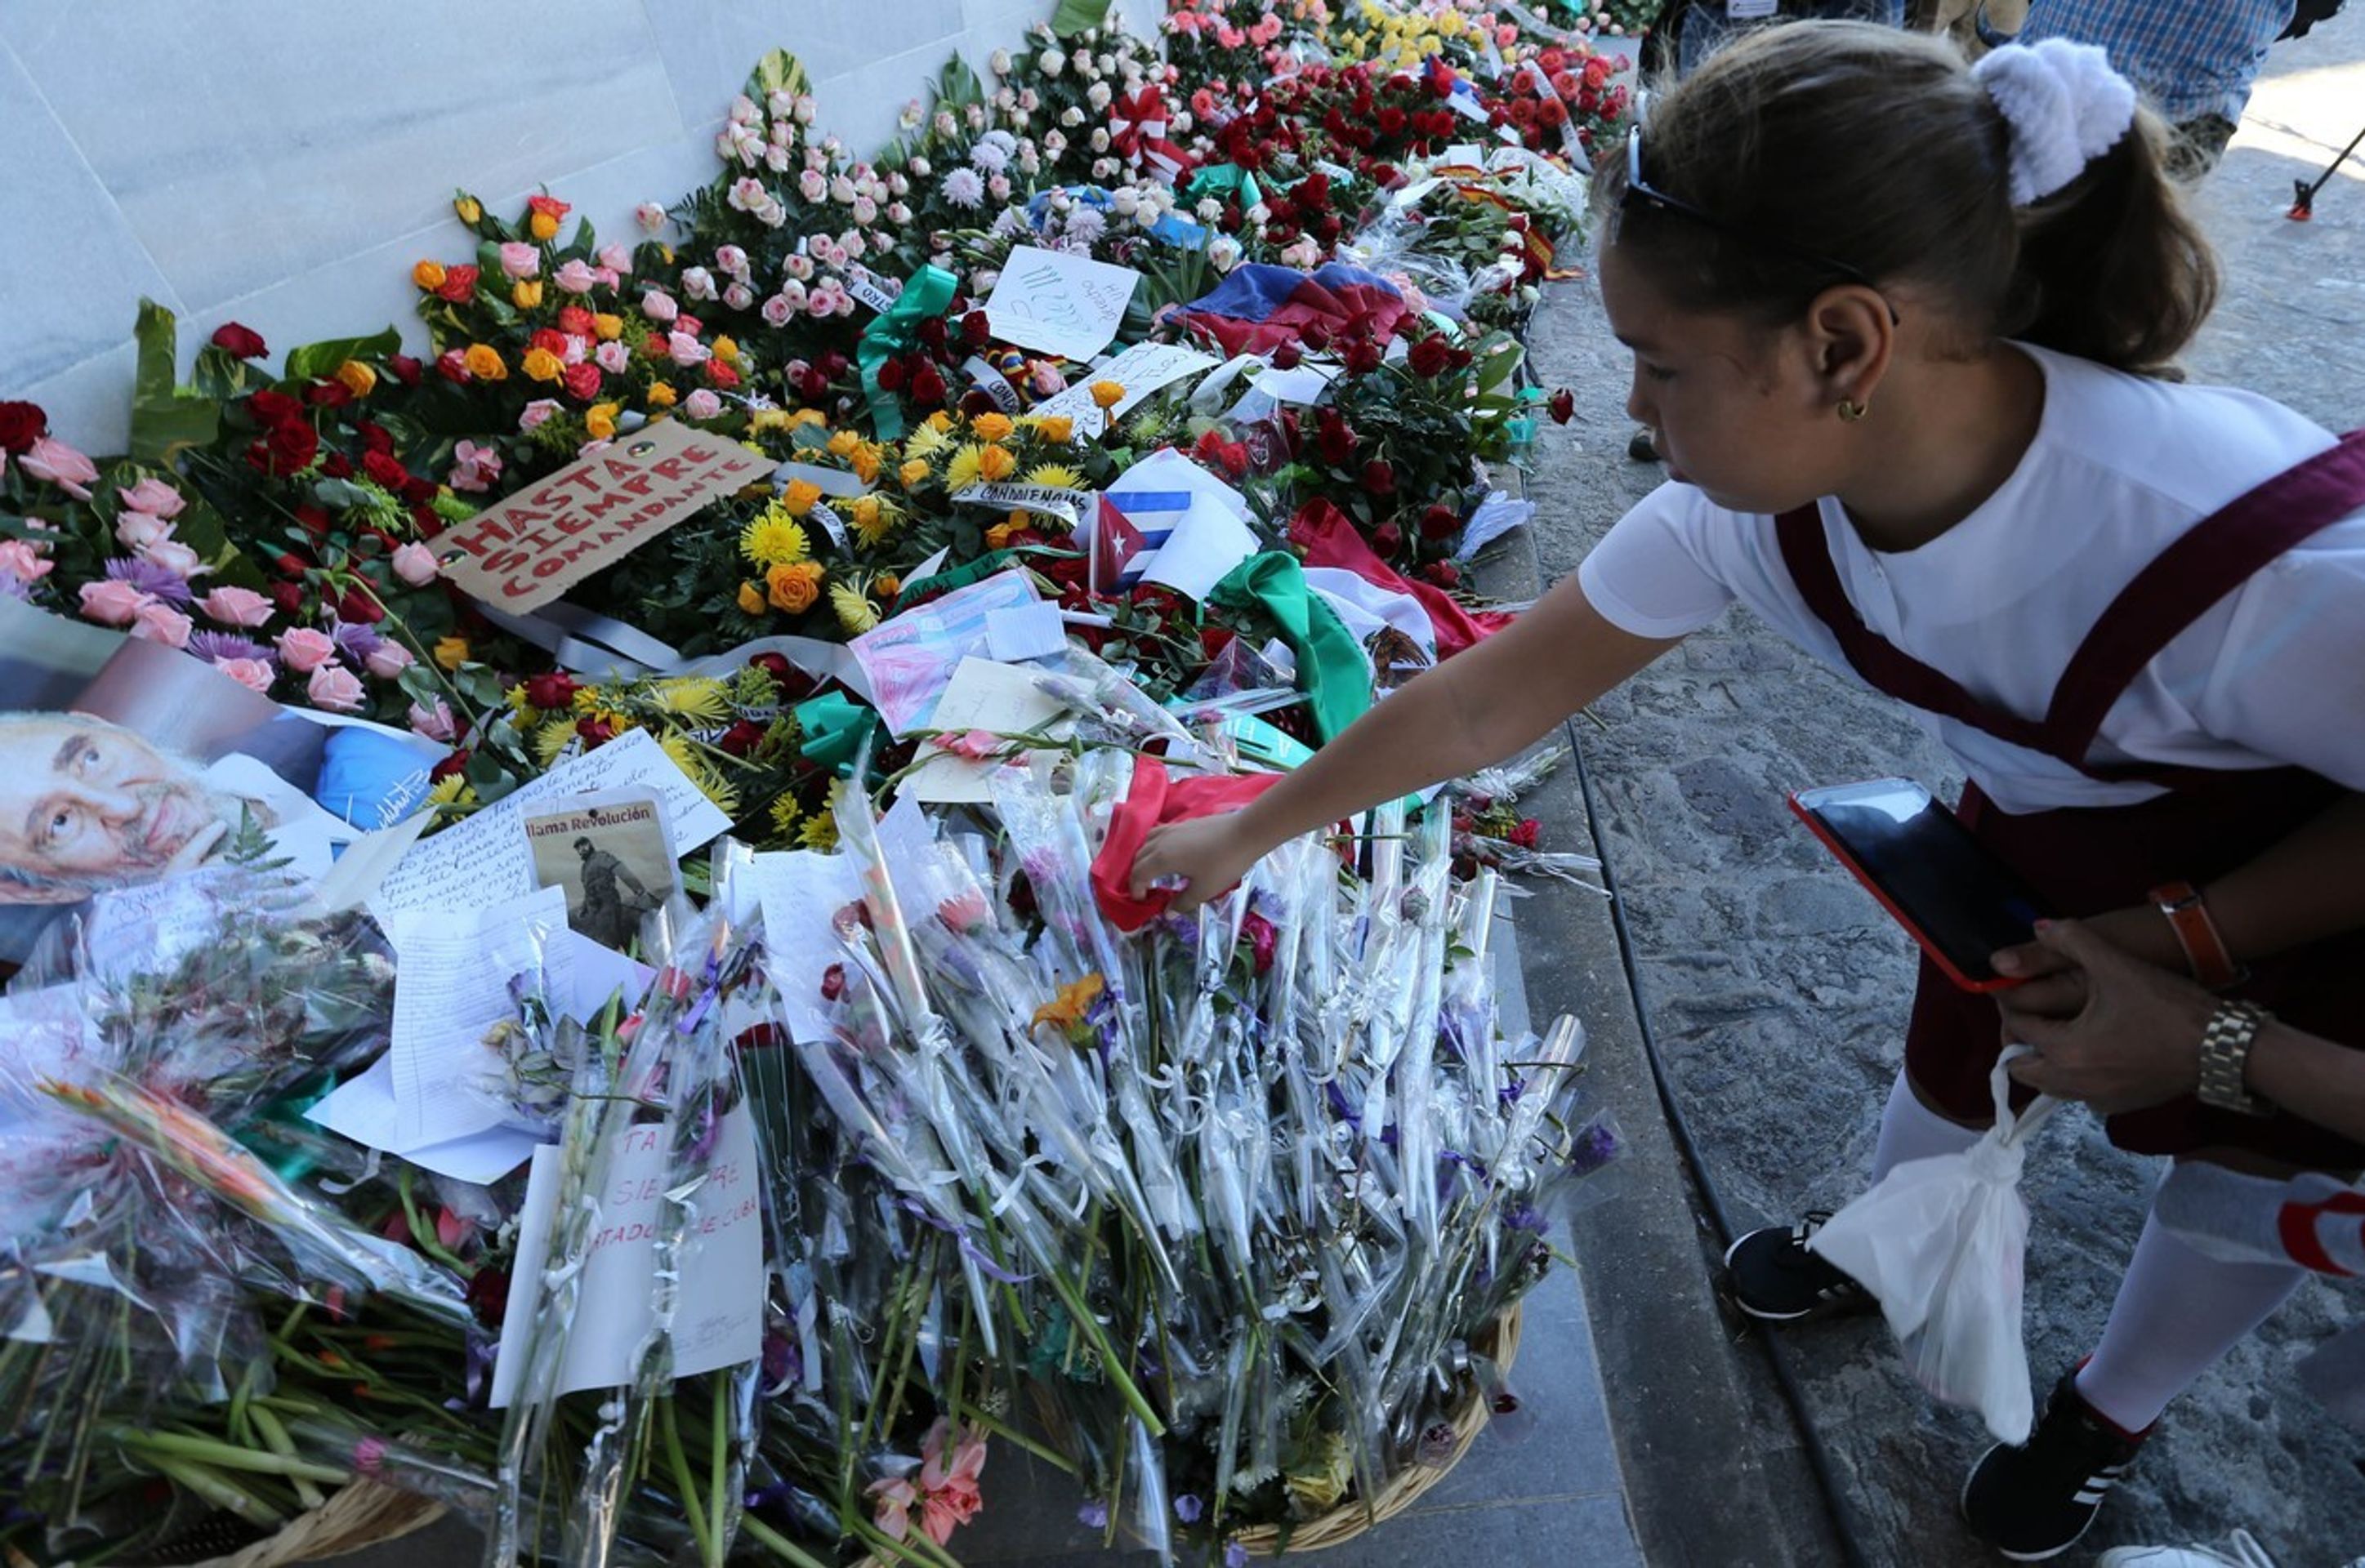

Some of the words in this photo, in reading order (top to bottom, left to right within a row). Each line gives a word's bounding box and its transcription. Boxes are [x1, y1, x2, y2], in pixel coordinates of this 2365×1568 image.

[450, 459, 643, 557] HASTA
[481, 445, 718, 574] SIEMPRE
[502, 460, 751, 598] COMANDANTE
[525, 822, 569, 839] llama
[570, 806, 651, 832] Revolución
